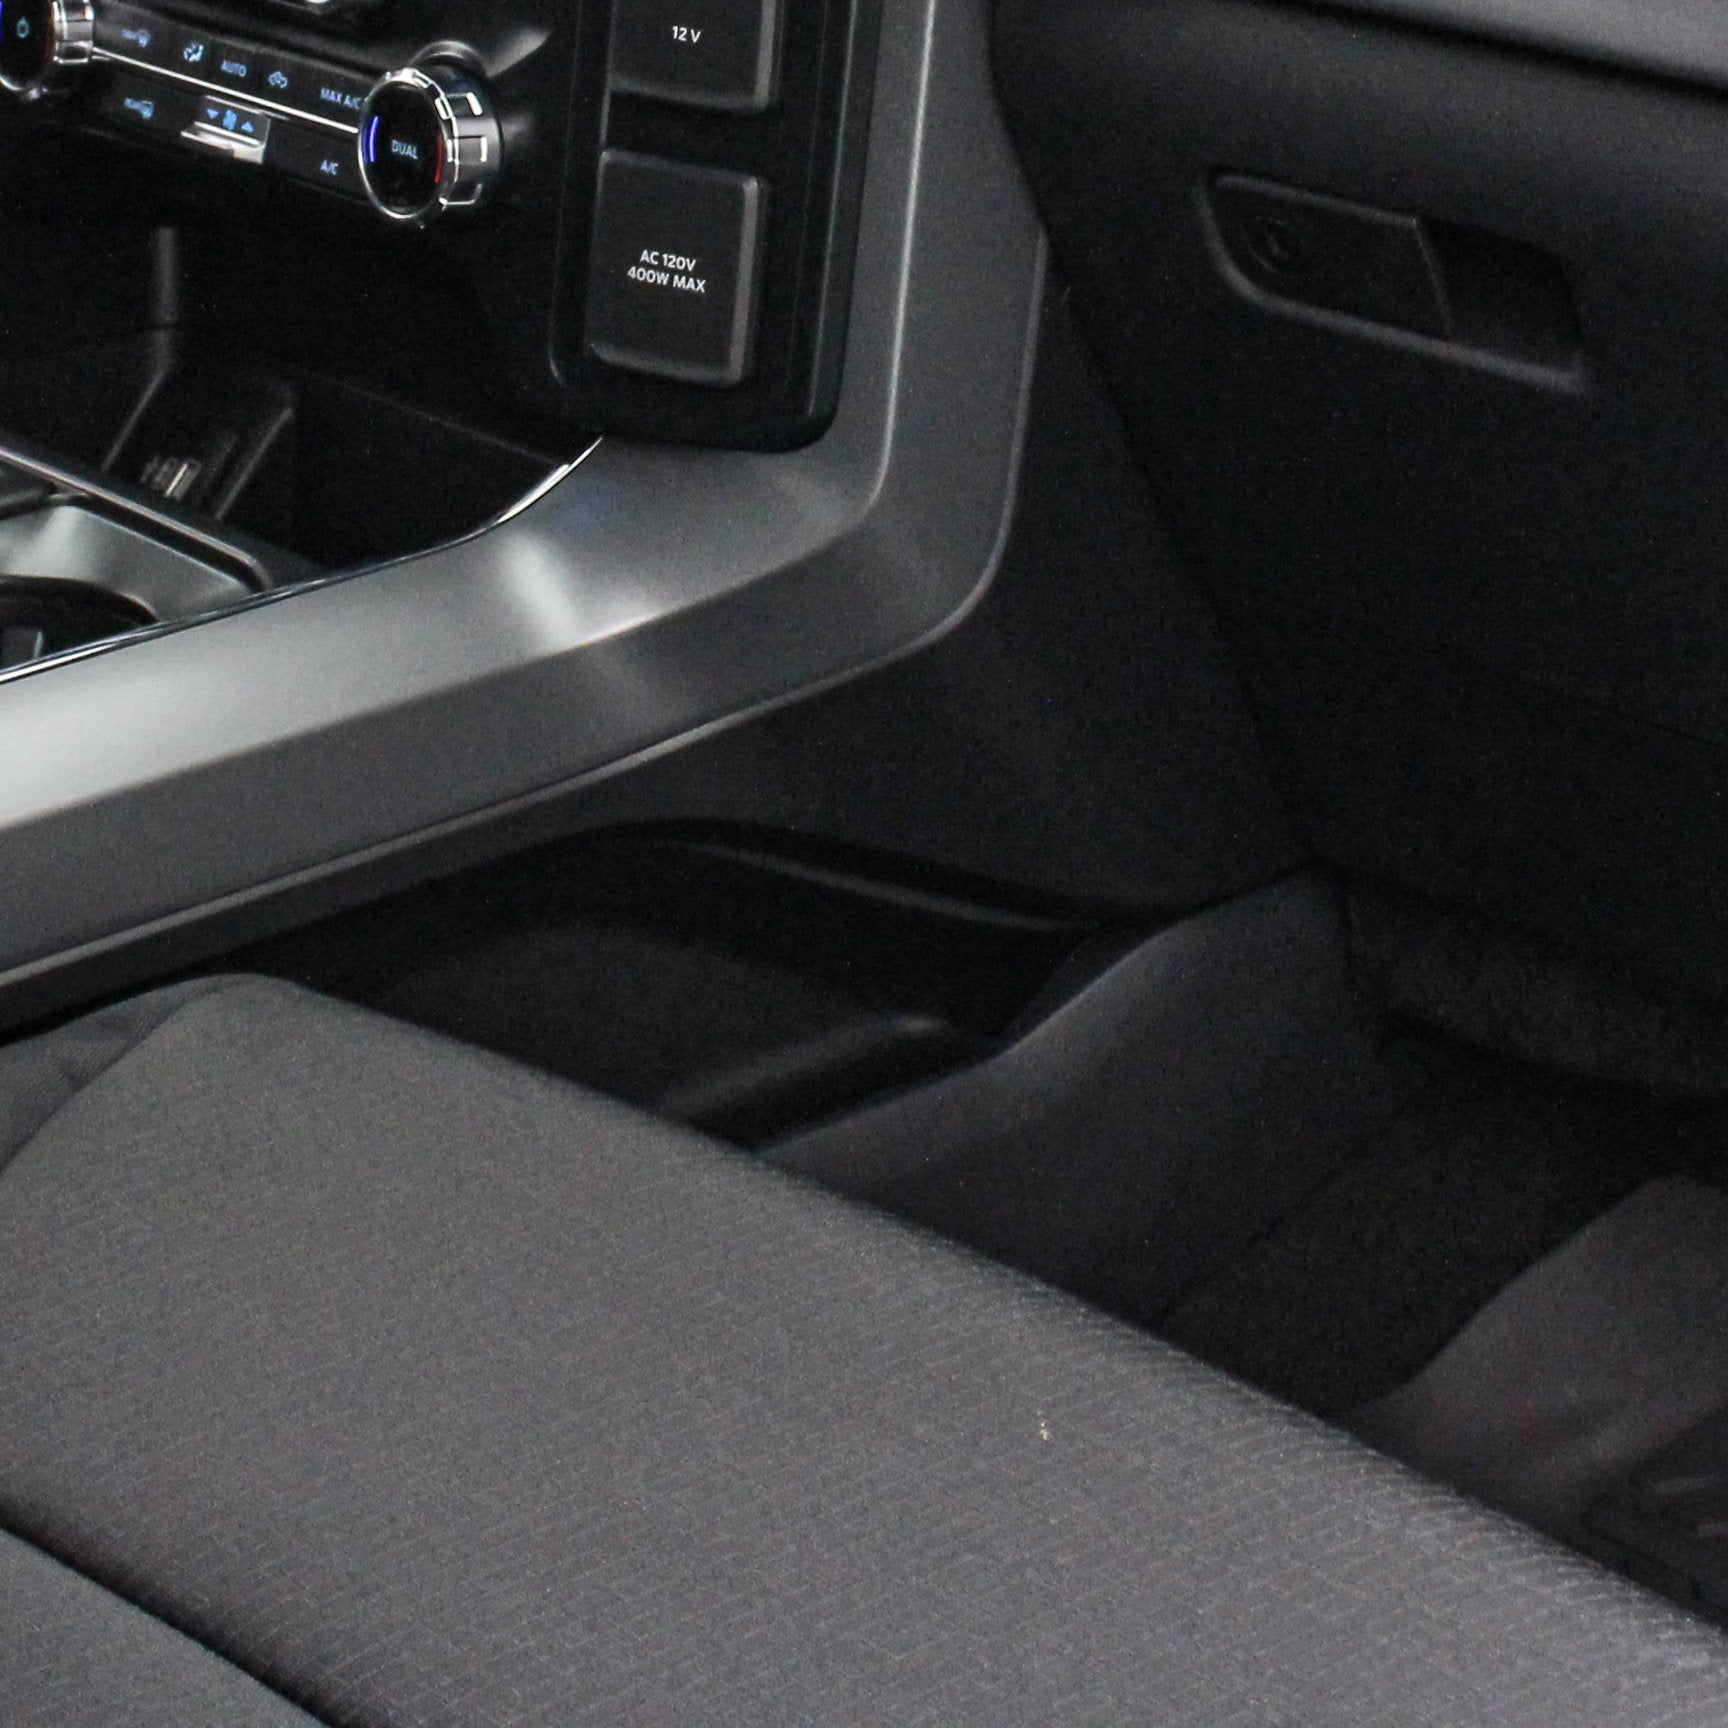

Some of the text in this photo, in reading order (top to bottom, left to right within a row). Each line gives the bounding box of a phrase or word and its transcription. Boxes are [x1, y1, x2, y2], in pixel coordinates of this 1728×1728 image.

[672, 25, 702, 43] 12 V
[221, 59, 248, 78] AUTO
[320, 87, 343, 105] MAX
[391, 139, 418, 161] DUAL
[320, 159, 339, 176] A/C
[639, 249, 697, 273] AC 120V
[626, 266, 707, 294] 400W MAX
